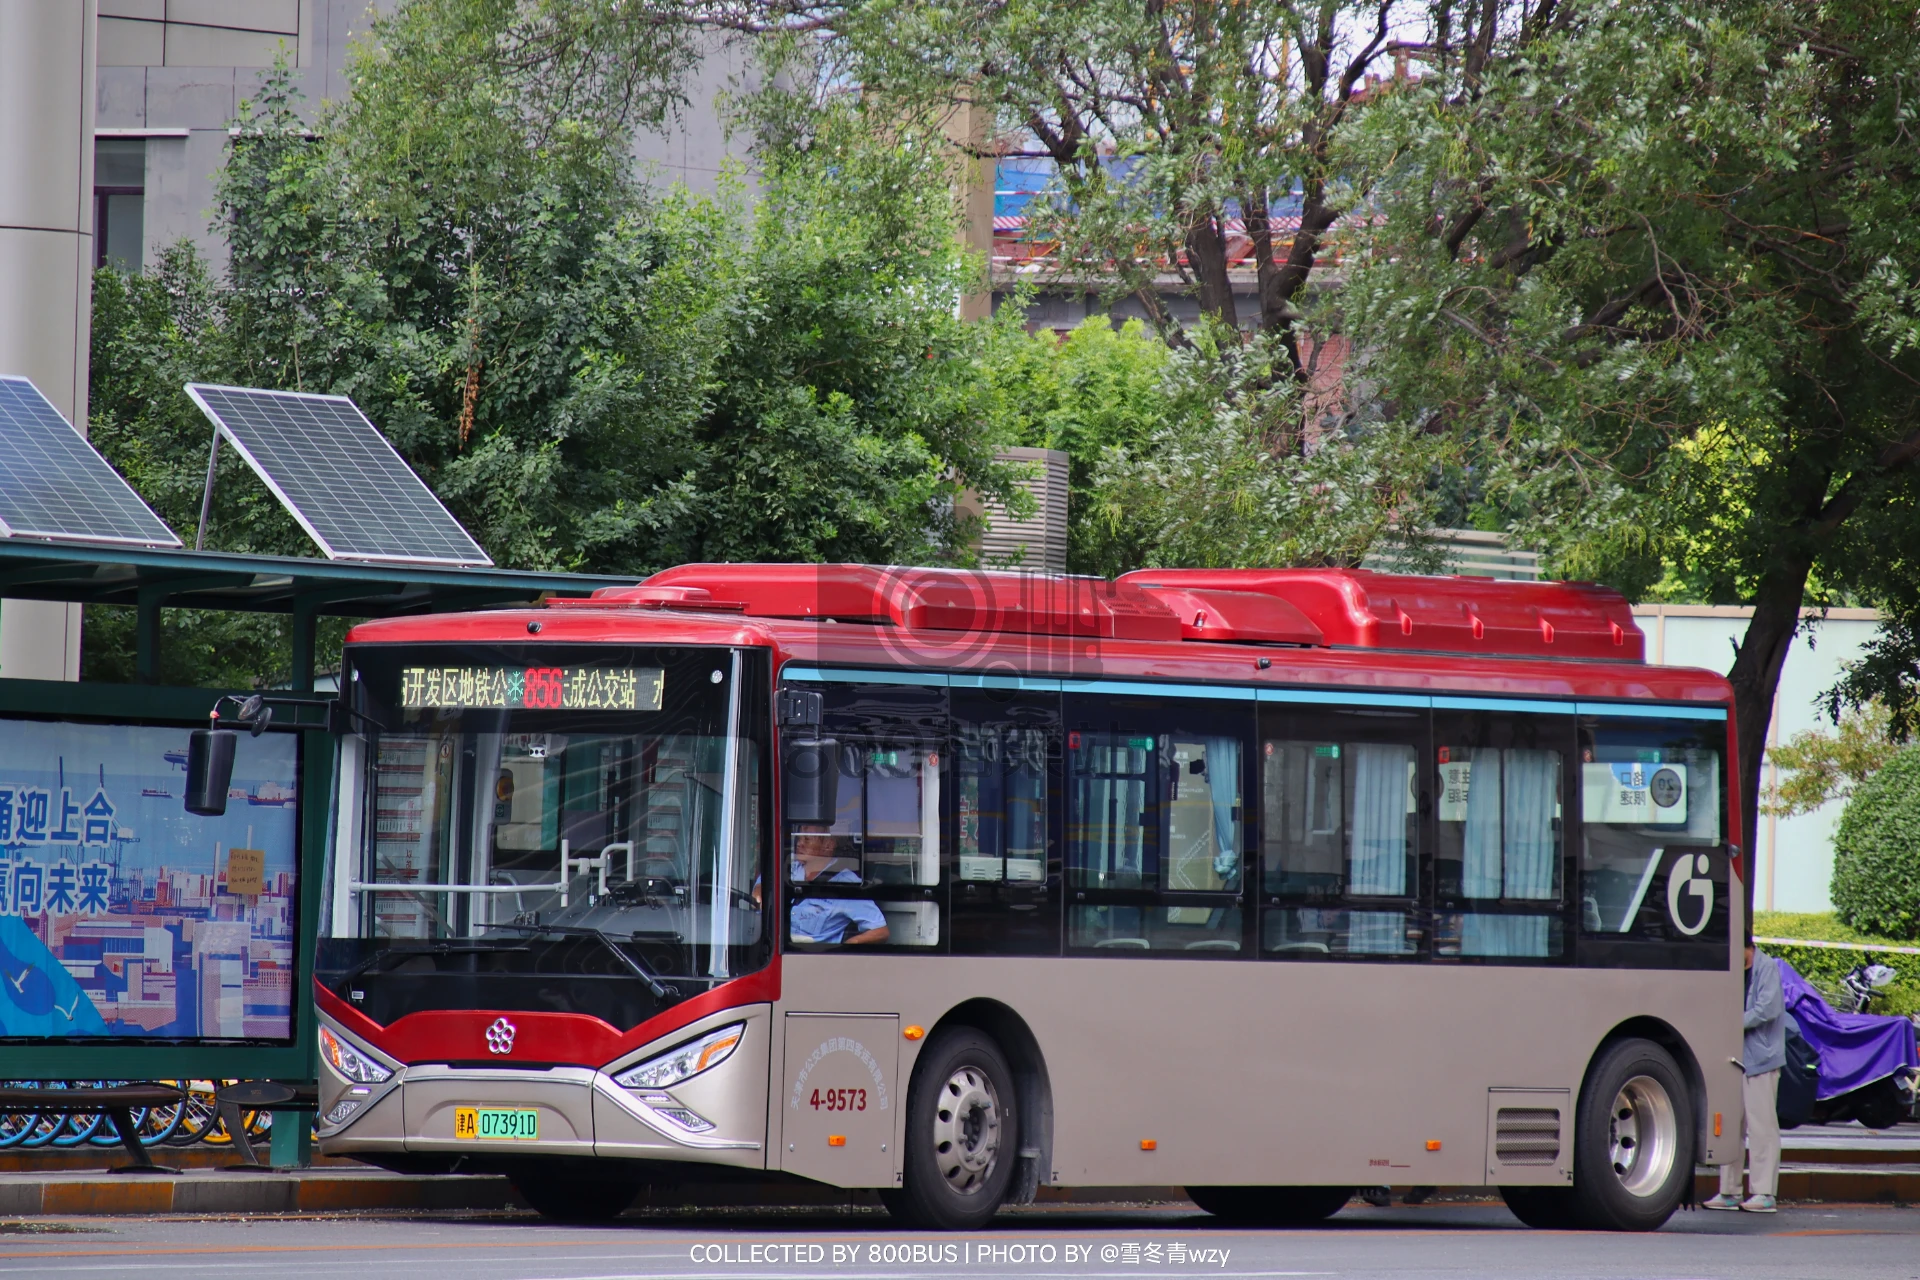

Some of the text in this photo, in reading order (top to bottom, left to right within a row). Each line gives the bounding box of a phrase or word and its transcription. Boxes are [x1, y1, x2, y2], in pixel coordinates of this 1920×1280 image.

[524, 668, 563, 709] 856
[0, 860, 109, 915] 向未来
[809, 1088, 868, 1111] 4-9573
